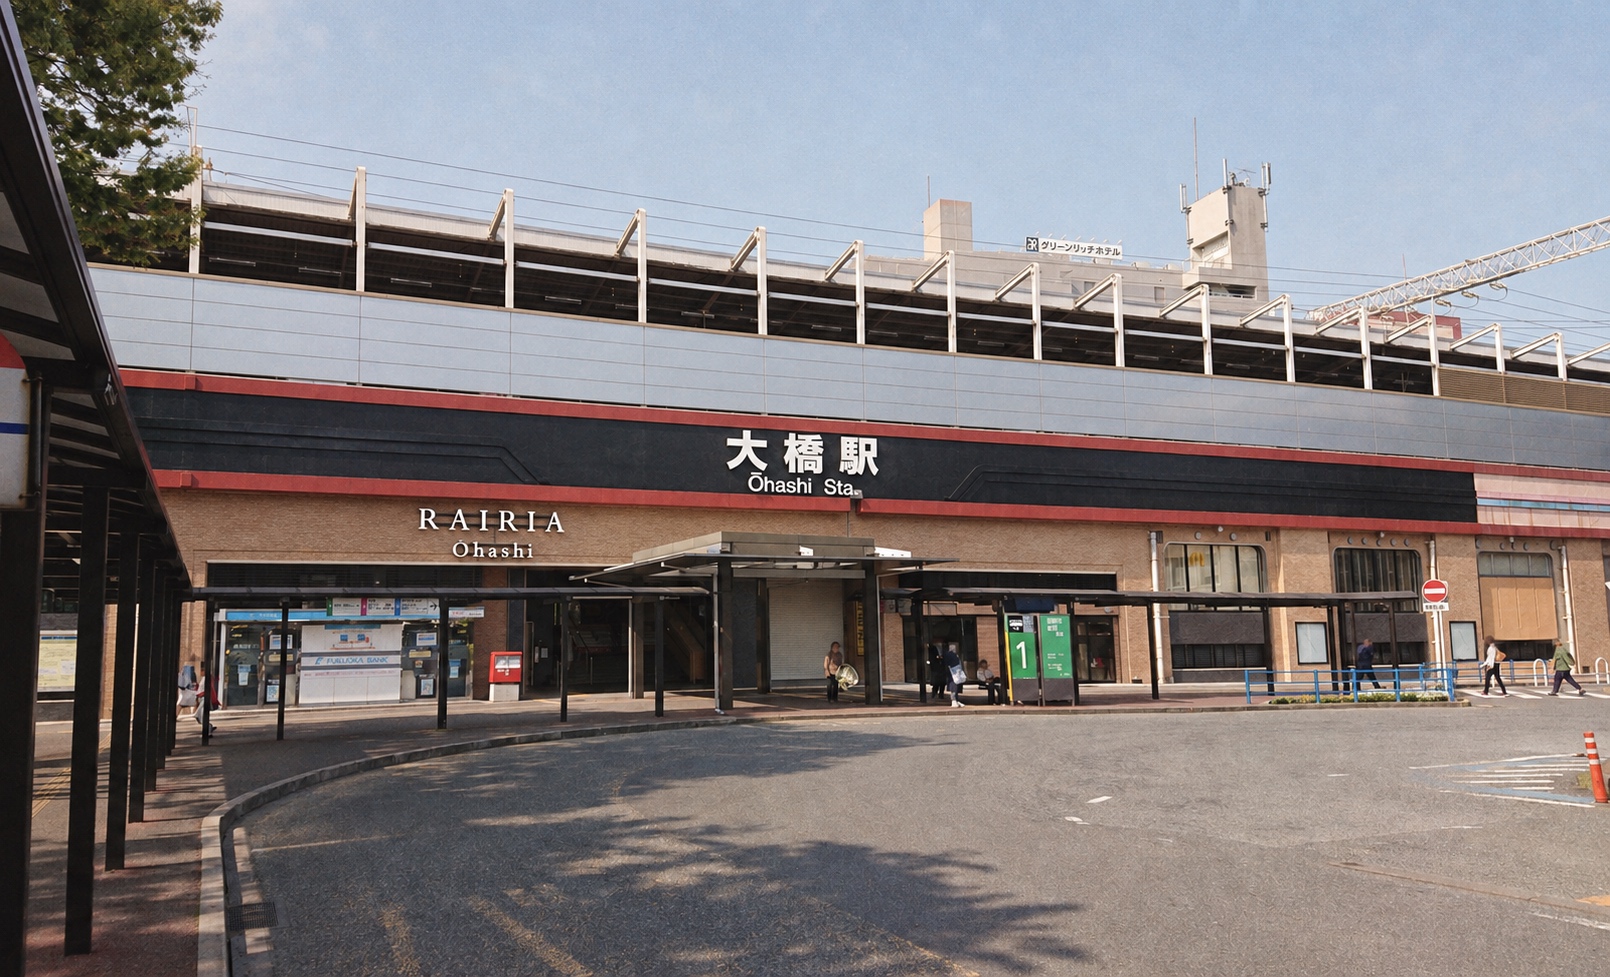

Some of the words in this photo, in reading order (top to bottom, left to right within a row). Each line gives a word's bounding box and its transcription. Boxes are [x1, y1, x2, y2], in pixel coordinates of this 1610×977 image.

[1041, 240, 1121, 256] グリーンリッチホテル
[726, 430, 879, 476] 大橋駅
[748, 471, 812, 494] Ōhashi
[418, 507, 565, 533] RAIRIA
[1015, 640, 1027, 669] 1
